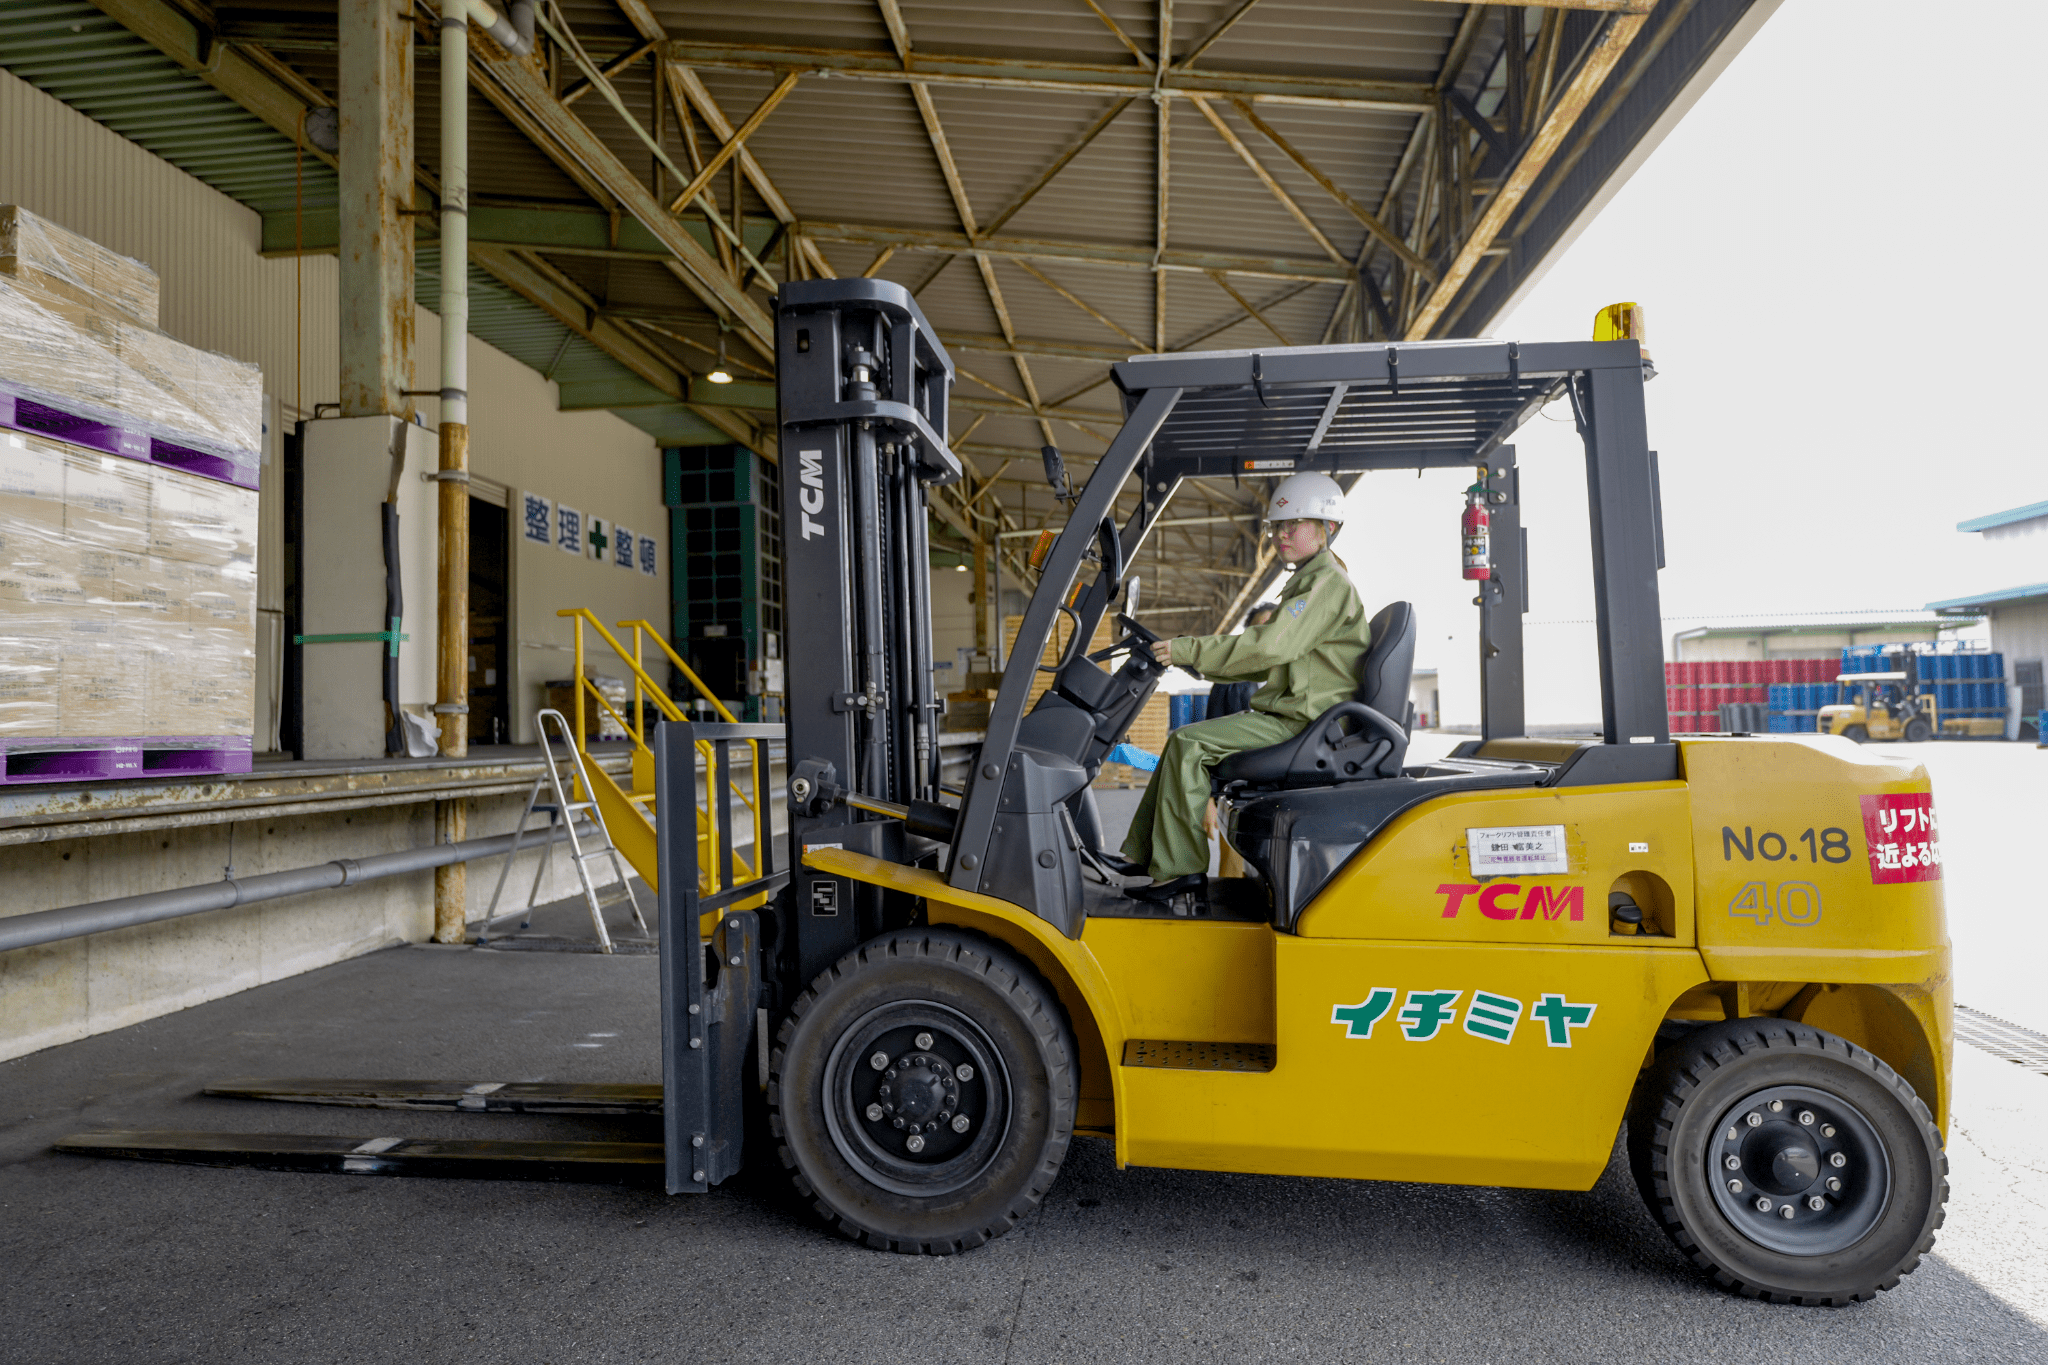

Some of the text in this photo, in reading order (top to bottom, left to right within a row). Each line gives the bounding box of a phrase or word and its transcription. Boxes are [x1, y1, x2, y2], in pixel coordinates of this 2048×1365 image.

[799, 449, 825, 541] TCM
[525, 495, 581, 554] 整理
[1721, 826, 1852, 864] No.18
[1435, 882, 1584, 921] TCM
[1728, 880, 1823, 927] 40
[1330, 986, 1598, 1048] イチミヤ
